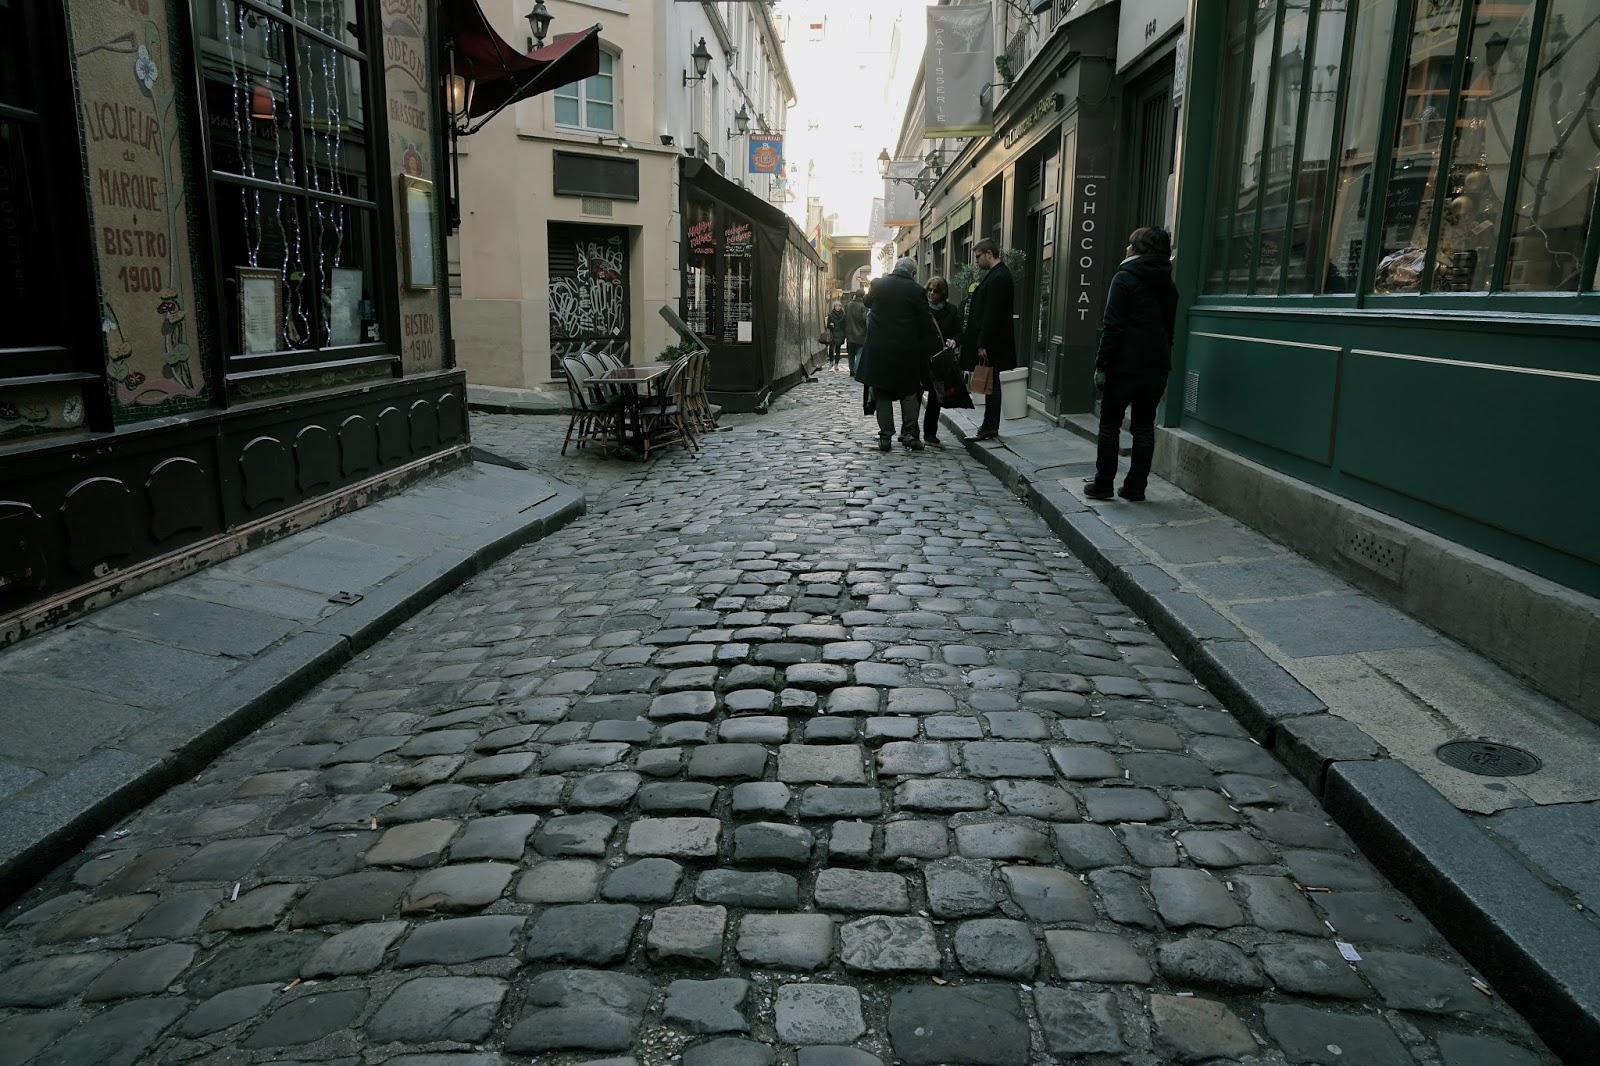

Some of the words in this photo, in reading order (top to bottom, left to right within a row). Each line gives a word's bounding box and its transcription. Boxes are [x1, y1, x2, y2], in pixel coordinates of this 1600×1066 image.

[387, 37, 425, 82] ODEON
[84, 101, 160, 156] LIQUEUR
[390, 98, 427, 131] BRASSERIE
[123, 149, 136, 162] de
[98, 167, 162, 212] MARQUE
[103, 227, 167, 258] BISTRO
[1077, 183, 1097, 321] CHOCOLAT
[118, 266, 162, 293] 1900
[404, 313, 434, 337] BISTRO
[409, 339, 432, 362] 1900
